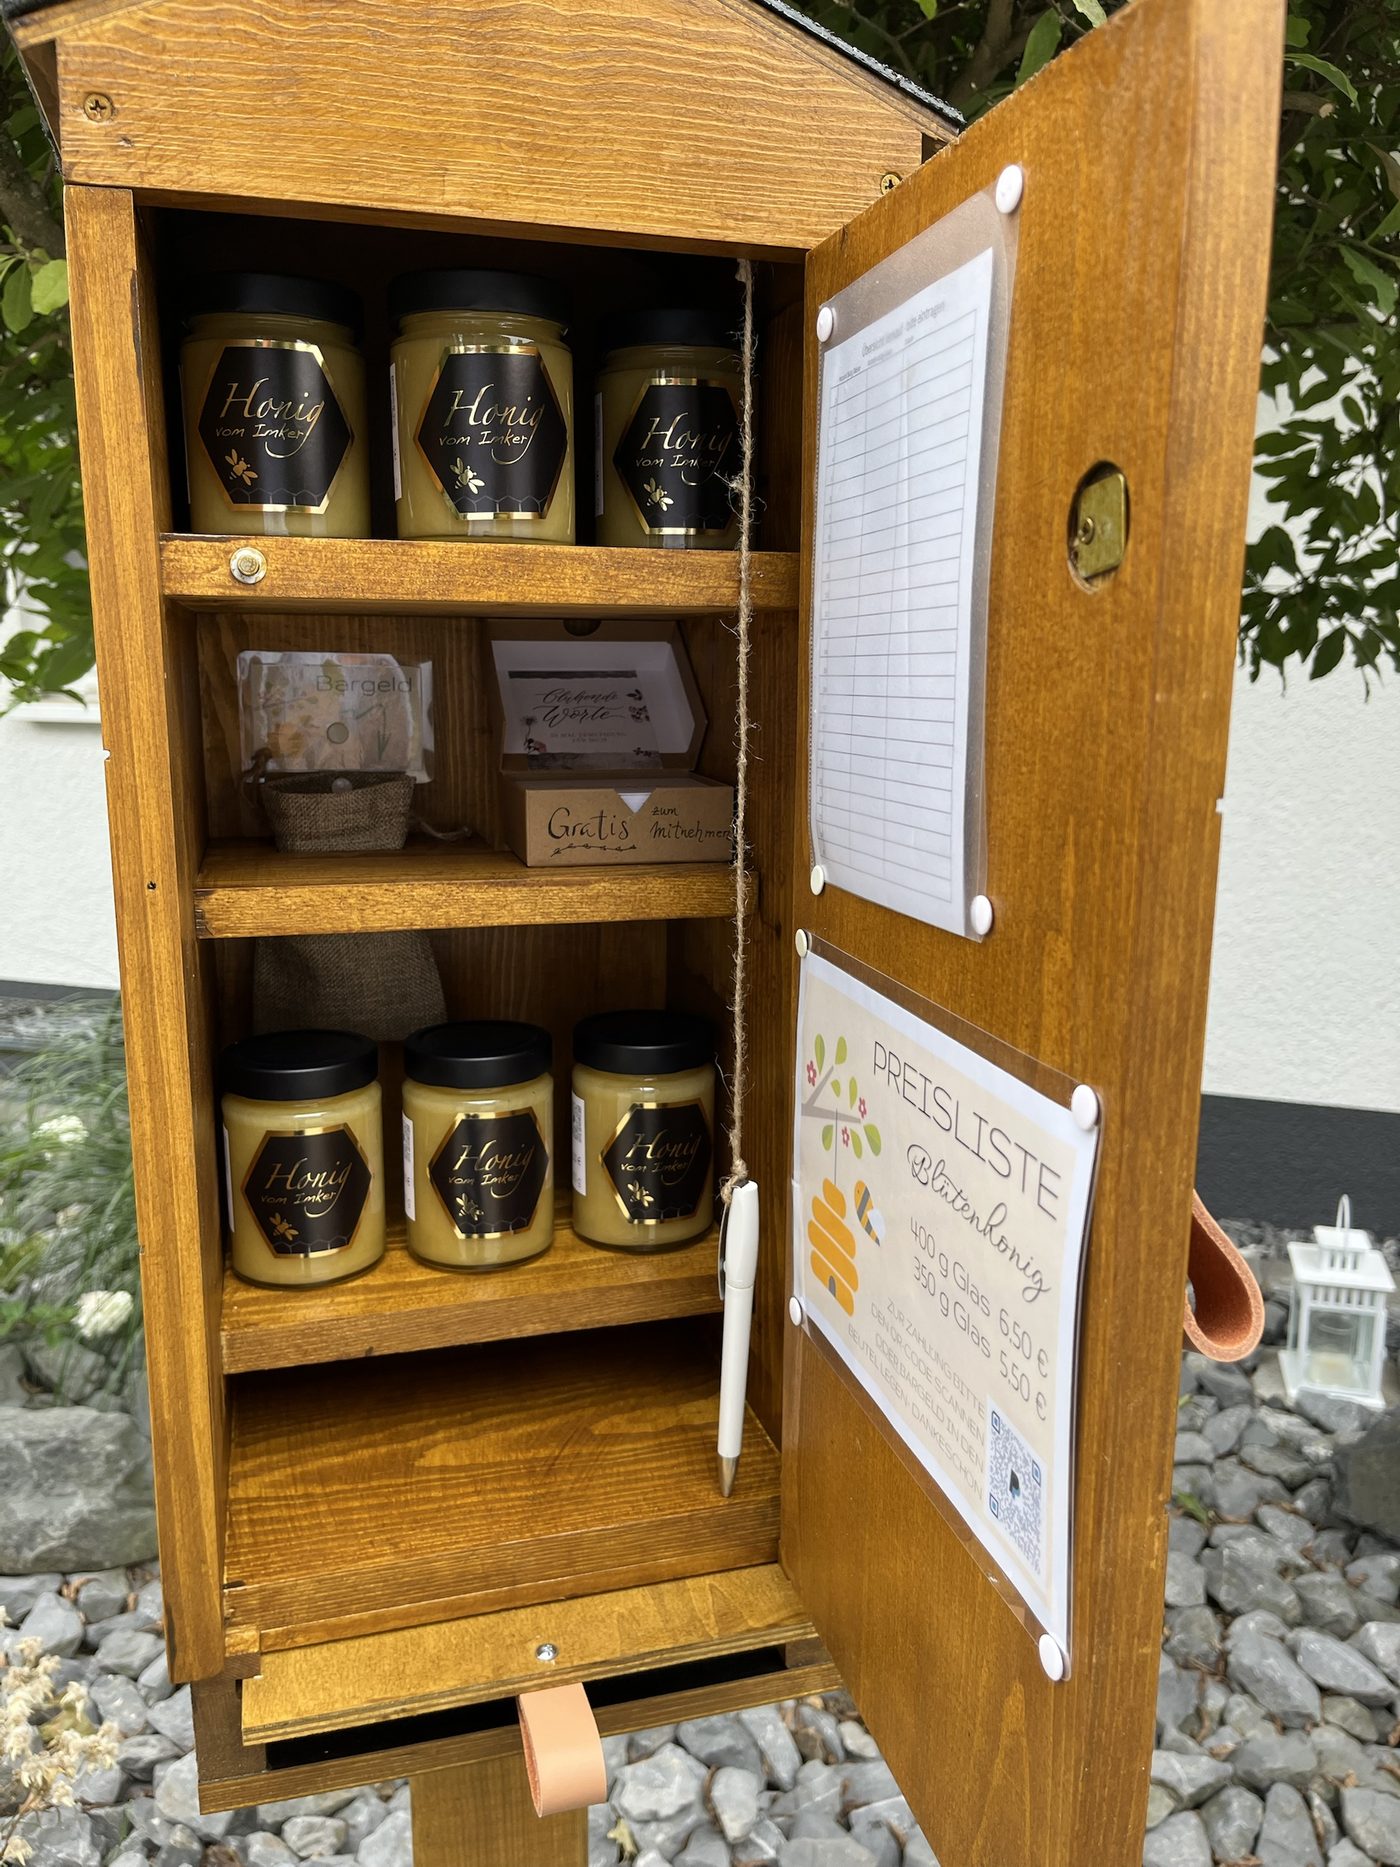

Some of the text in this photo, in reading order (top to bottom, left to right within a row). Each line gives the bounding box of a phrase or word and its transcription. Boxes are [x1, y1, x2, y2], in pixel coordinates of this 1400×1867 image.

[215, 423, 305, 440] vom Imker
[219, 377, 325, 459] Honig
[439, 428, 528, 446] vom Imker
[443, 383, 546, 465] Honig
[635, 454, 715, 469] vom Imker
[640, 412, 733, 485] Honig
[316, 675, 412, 697] Bargeld
[547, 806, 629, 840] Gratis
[651, 806, 679, 817] zum
[625, 1129, 702, 1185] Honig
[873, 1040, 1061, 1222] PREISLISTE
[260, 1188, 337, 1205] vom Imker
[264, 1157, 353, 1218] Honig
[448, 1171, 520, 1185] vom Imker
[452, 1139, 536, 1198] Honig
[620, 1163, 647, 1172] vom
[906, 1144, 1052, 1303] Blütenhonig
[910, 1216, 935, 1259] 400
[938, 1252, 949, 1278] g
[953, 1261, 990, 1317] Glas
[1037, 1348, 1049, 1378] €
[848, 1322, 879, 1370] BEUTEL
[887, 1297, 985, 1420] ZUR ZAHLUNG BITTE
[913, 1256, 936, 1296] 350
[939, 1291, 949, 1317] g
[953, 1301, 991, 1358] Glas
[1036, 1391, 1047, 1421] €
[871, 1303, 889, 1332] DEN
[934, 1376, 985, 1447] SCANNEN
[875, 1332, 984, 1473] ODER BARGELD IN DEN
